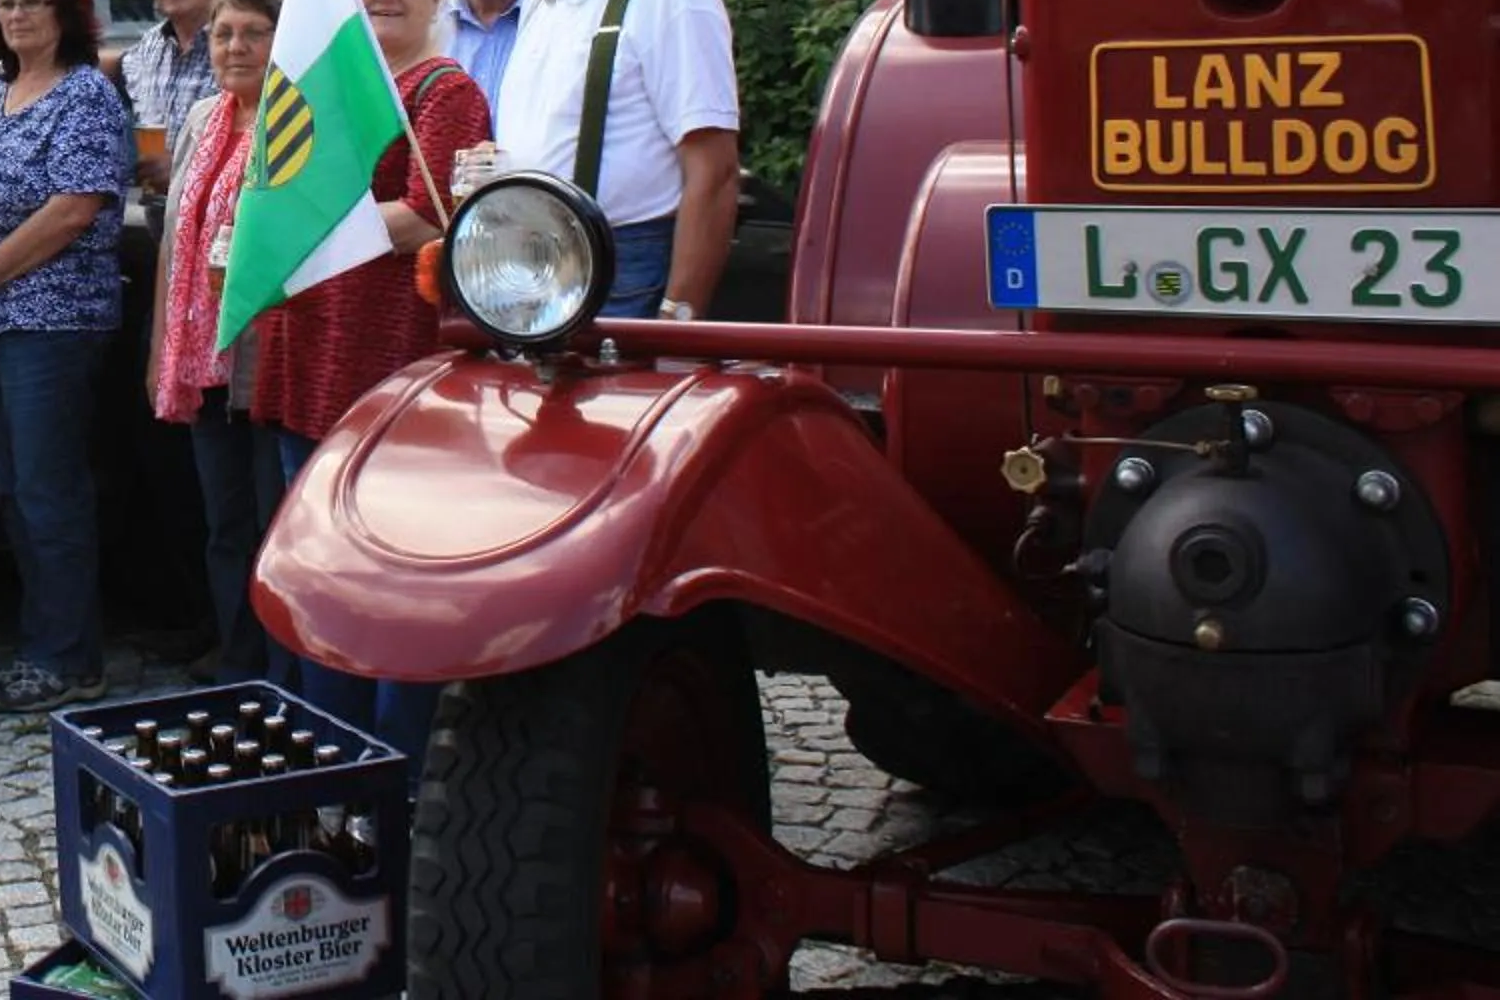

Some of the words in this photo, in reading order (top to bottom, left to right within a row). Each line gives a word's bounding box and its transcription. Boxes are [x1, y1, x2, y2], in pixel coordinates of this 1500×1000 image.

[1152, 51, 1344, 109] LANZ
[1103, 116, 1419, 176] BULLDOG
[1007, 268, 1024, 289] D
[1085, 225, 1138, 299] L
[1196, 226, 1309, 305] GX
[1350, 228, 1462, 308] 23
[226, 915, 371, 957] Weltenburger
[237, 948, 315, 977] Kloster
[318, 939, 363, 962] Bier
